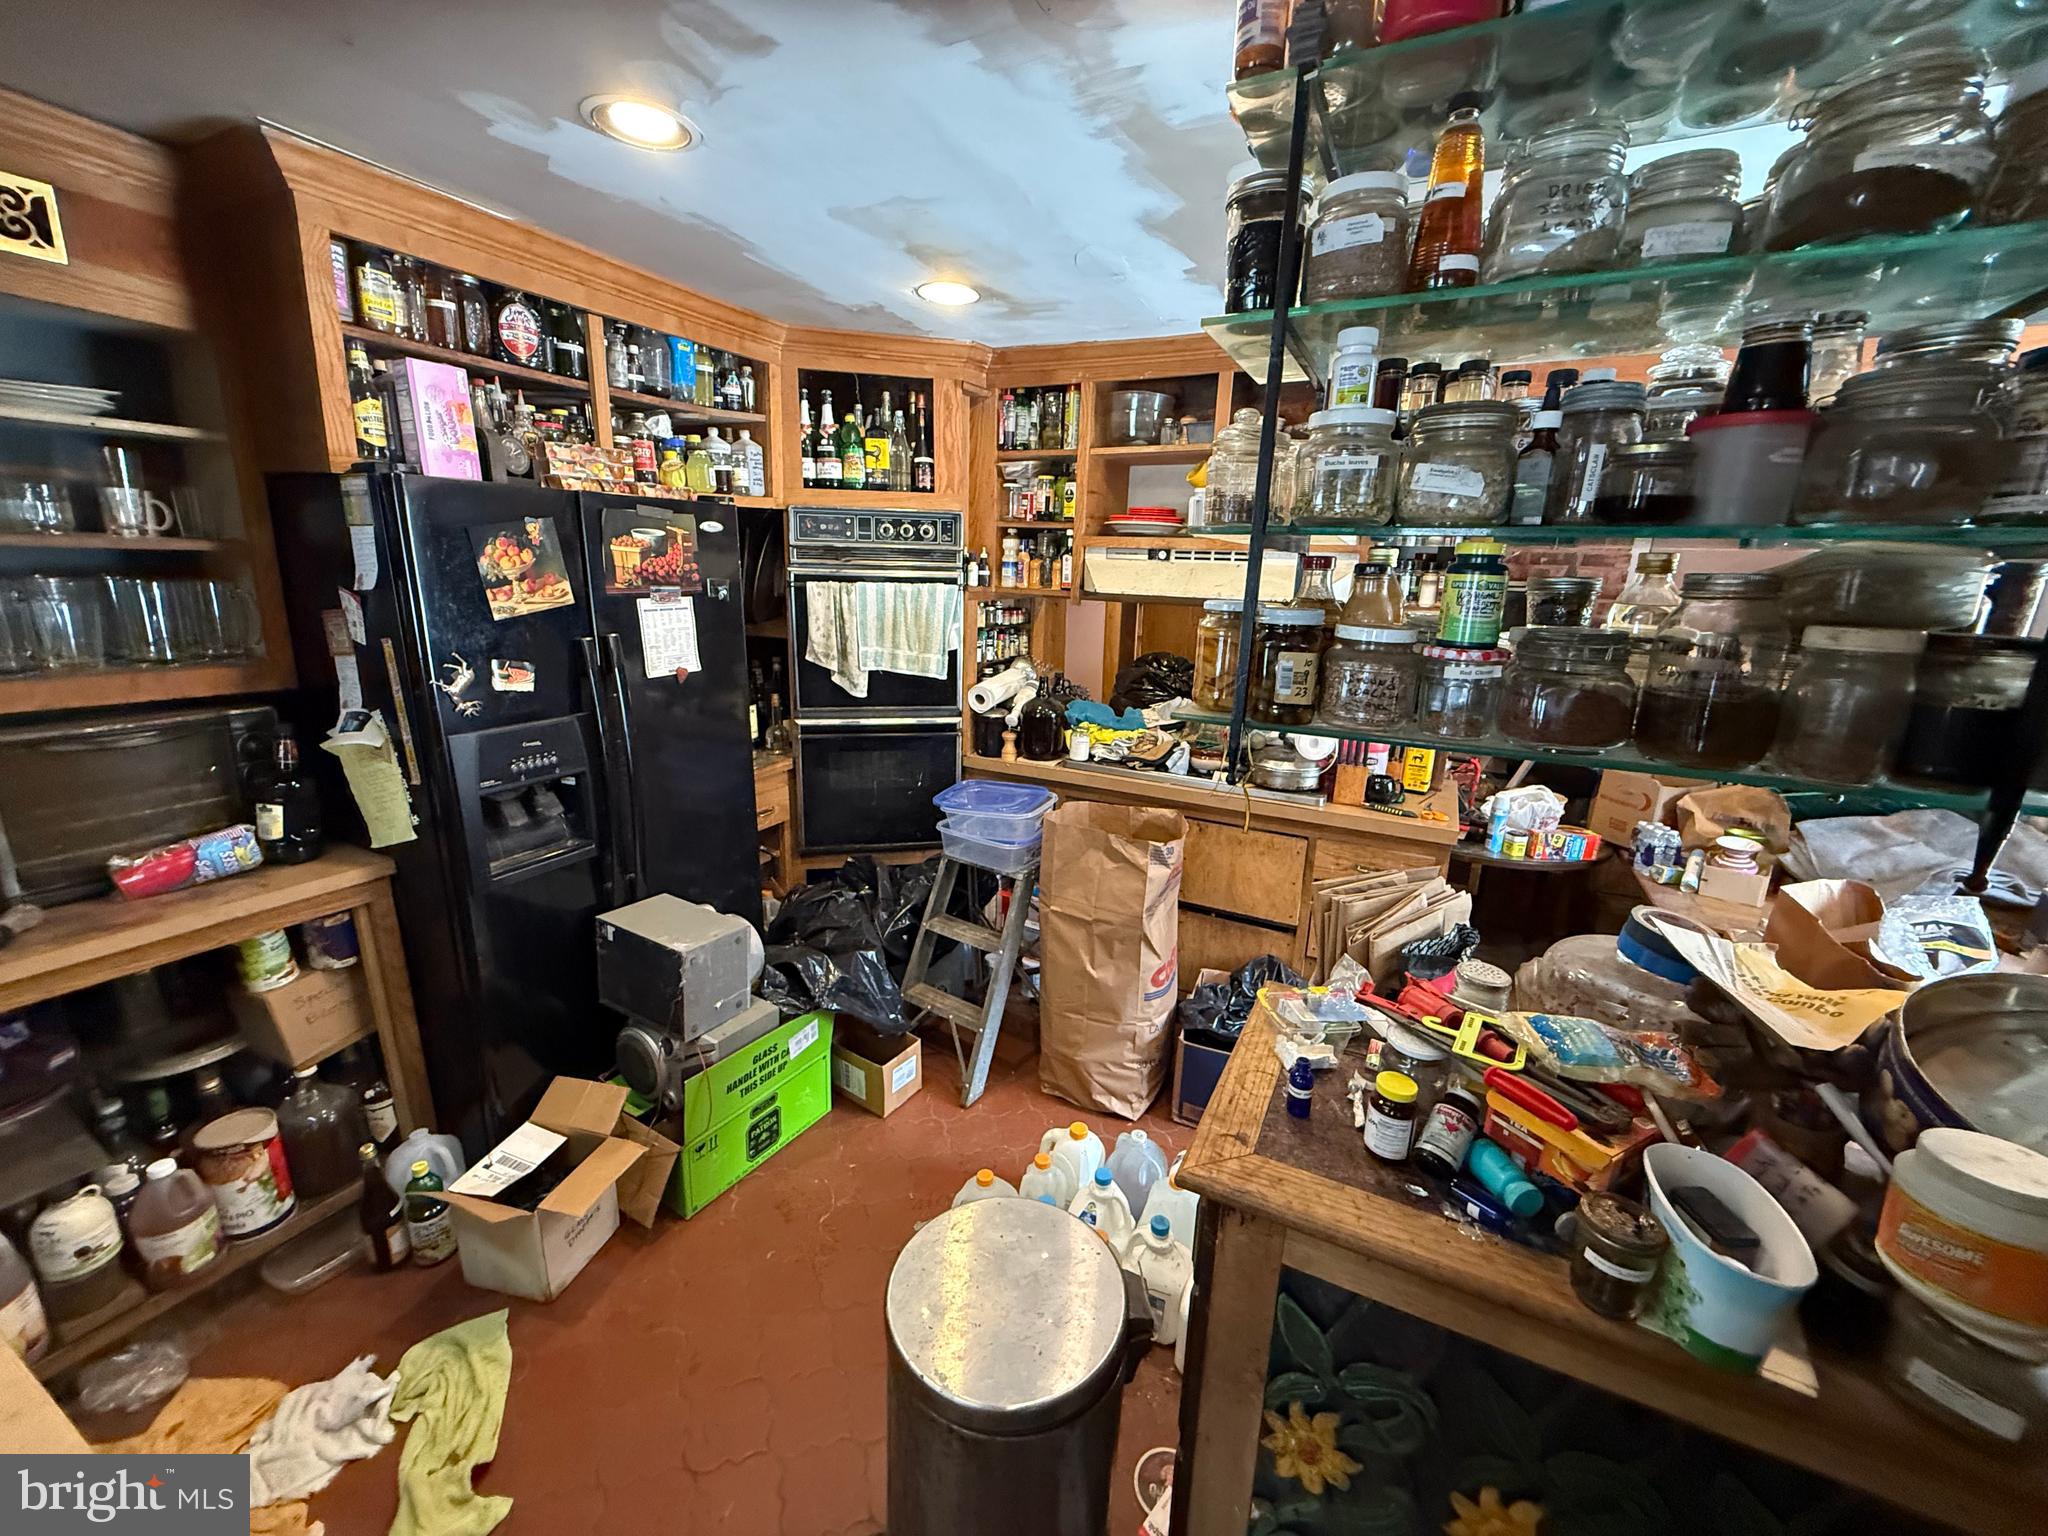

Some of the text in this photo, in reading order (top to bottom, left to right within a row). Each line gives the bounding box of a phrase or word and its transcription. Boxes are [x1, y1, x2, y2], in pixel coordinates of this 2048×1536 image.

[1294, 686, 1308, 698] 23
[752, 1042, 778, 1066] GLASS
[726, 1066, 757, 1095] HANDLE
[758, 1053, 780, 1074] WITH
[740, 1060, 788, 1098] THIS SIDE UP
